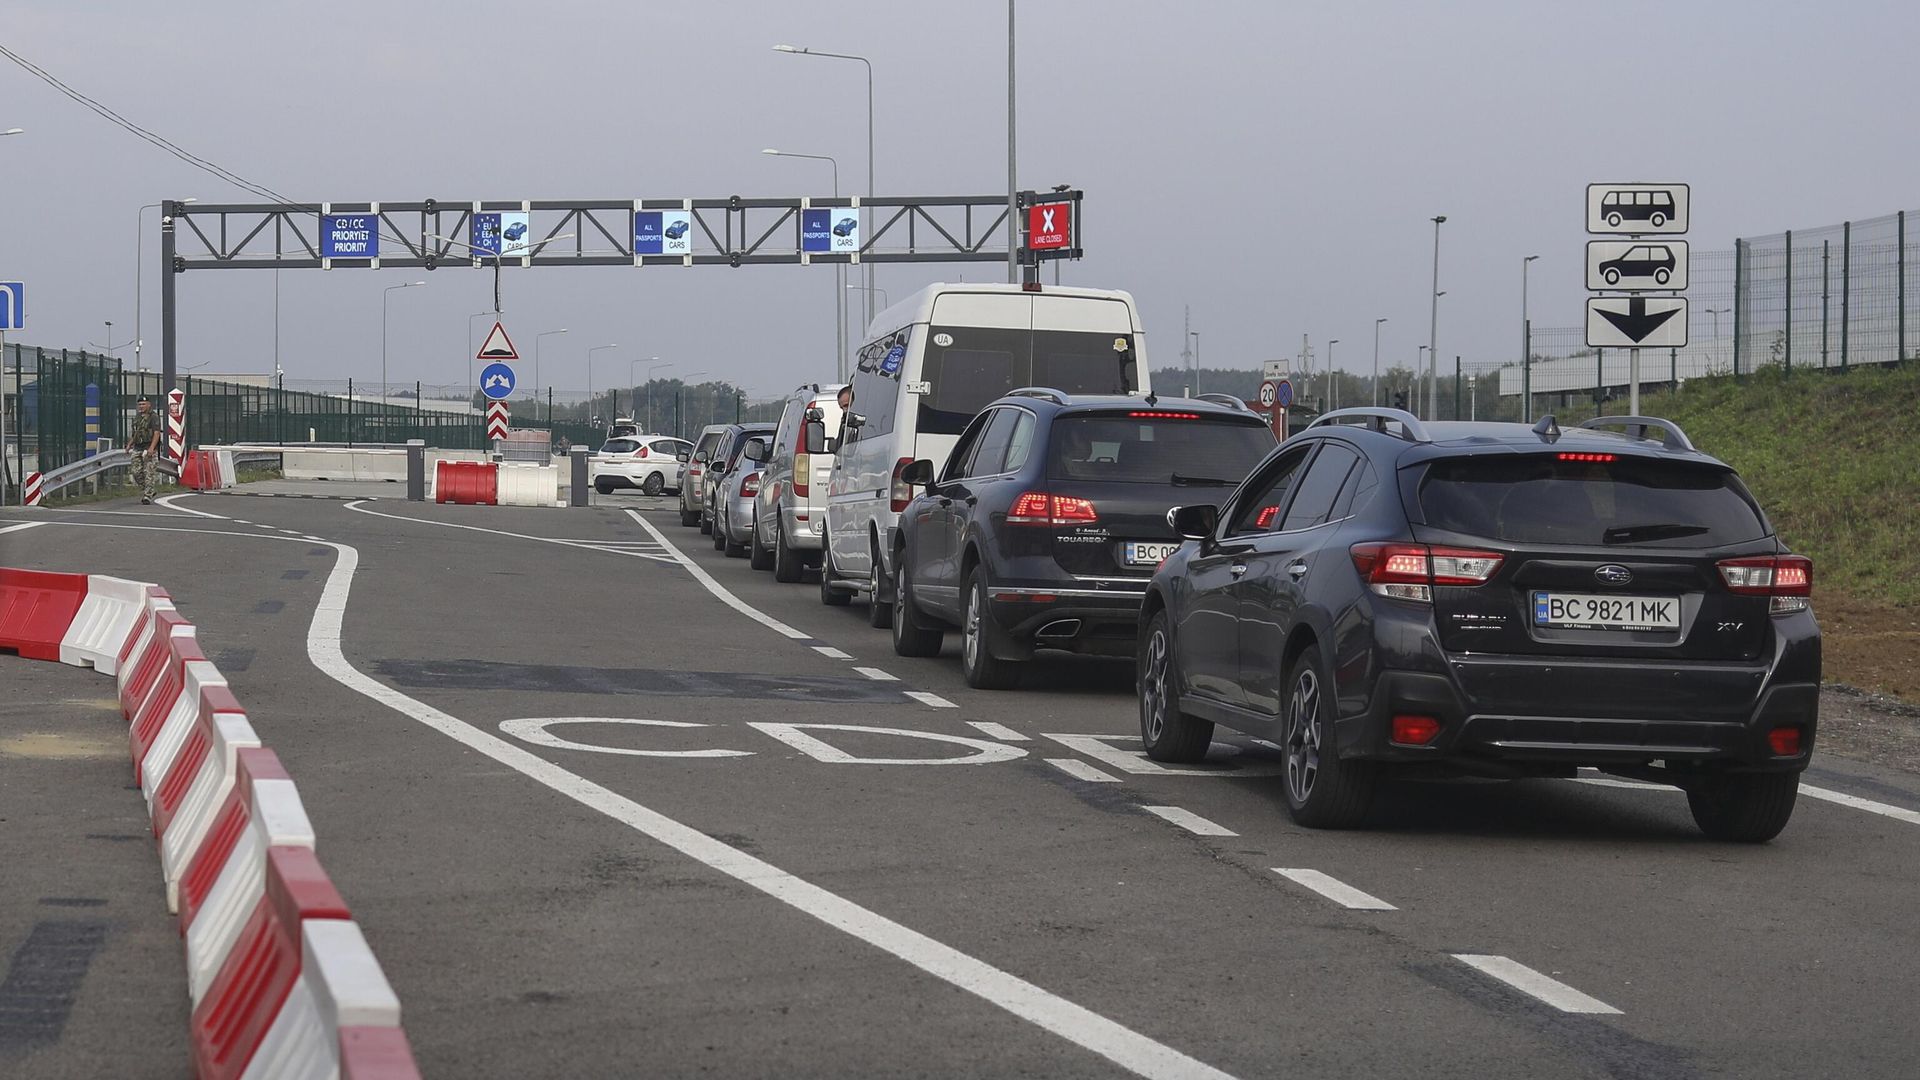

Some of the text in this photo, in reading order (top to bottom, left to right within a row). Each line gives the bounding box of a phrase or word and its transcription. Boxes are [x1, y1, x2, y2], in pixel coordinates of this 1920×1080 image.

[336, 219, 347, 228] CD
[353, 219, 364, 228] CC
[1035, 234, 1062, 244] LANE CLOSED
[335, 242, 367, 252] PRIORITY
[938, 335, 948, 344] UA
[1262, 389, 1274, 402] 20
[1137, 545, 1157, 559] BC
[1537, 611, 1548, 619] UA
[1550, 598, 1671, 622] BC 9821 MK
[498, 717, 1030, 764] CD
